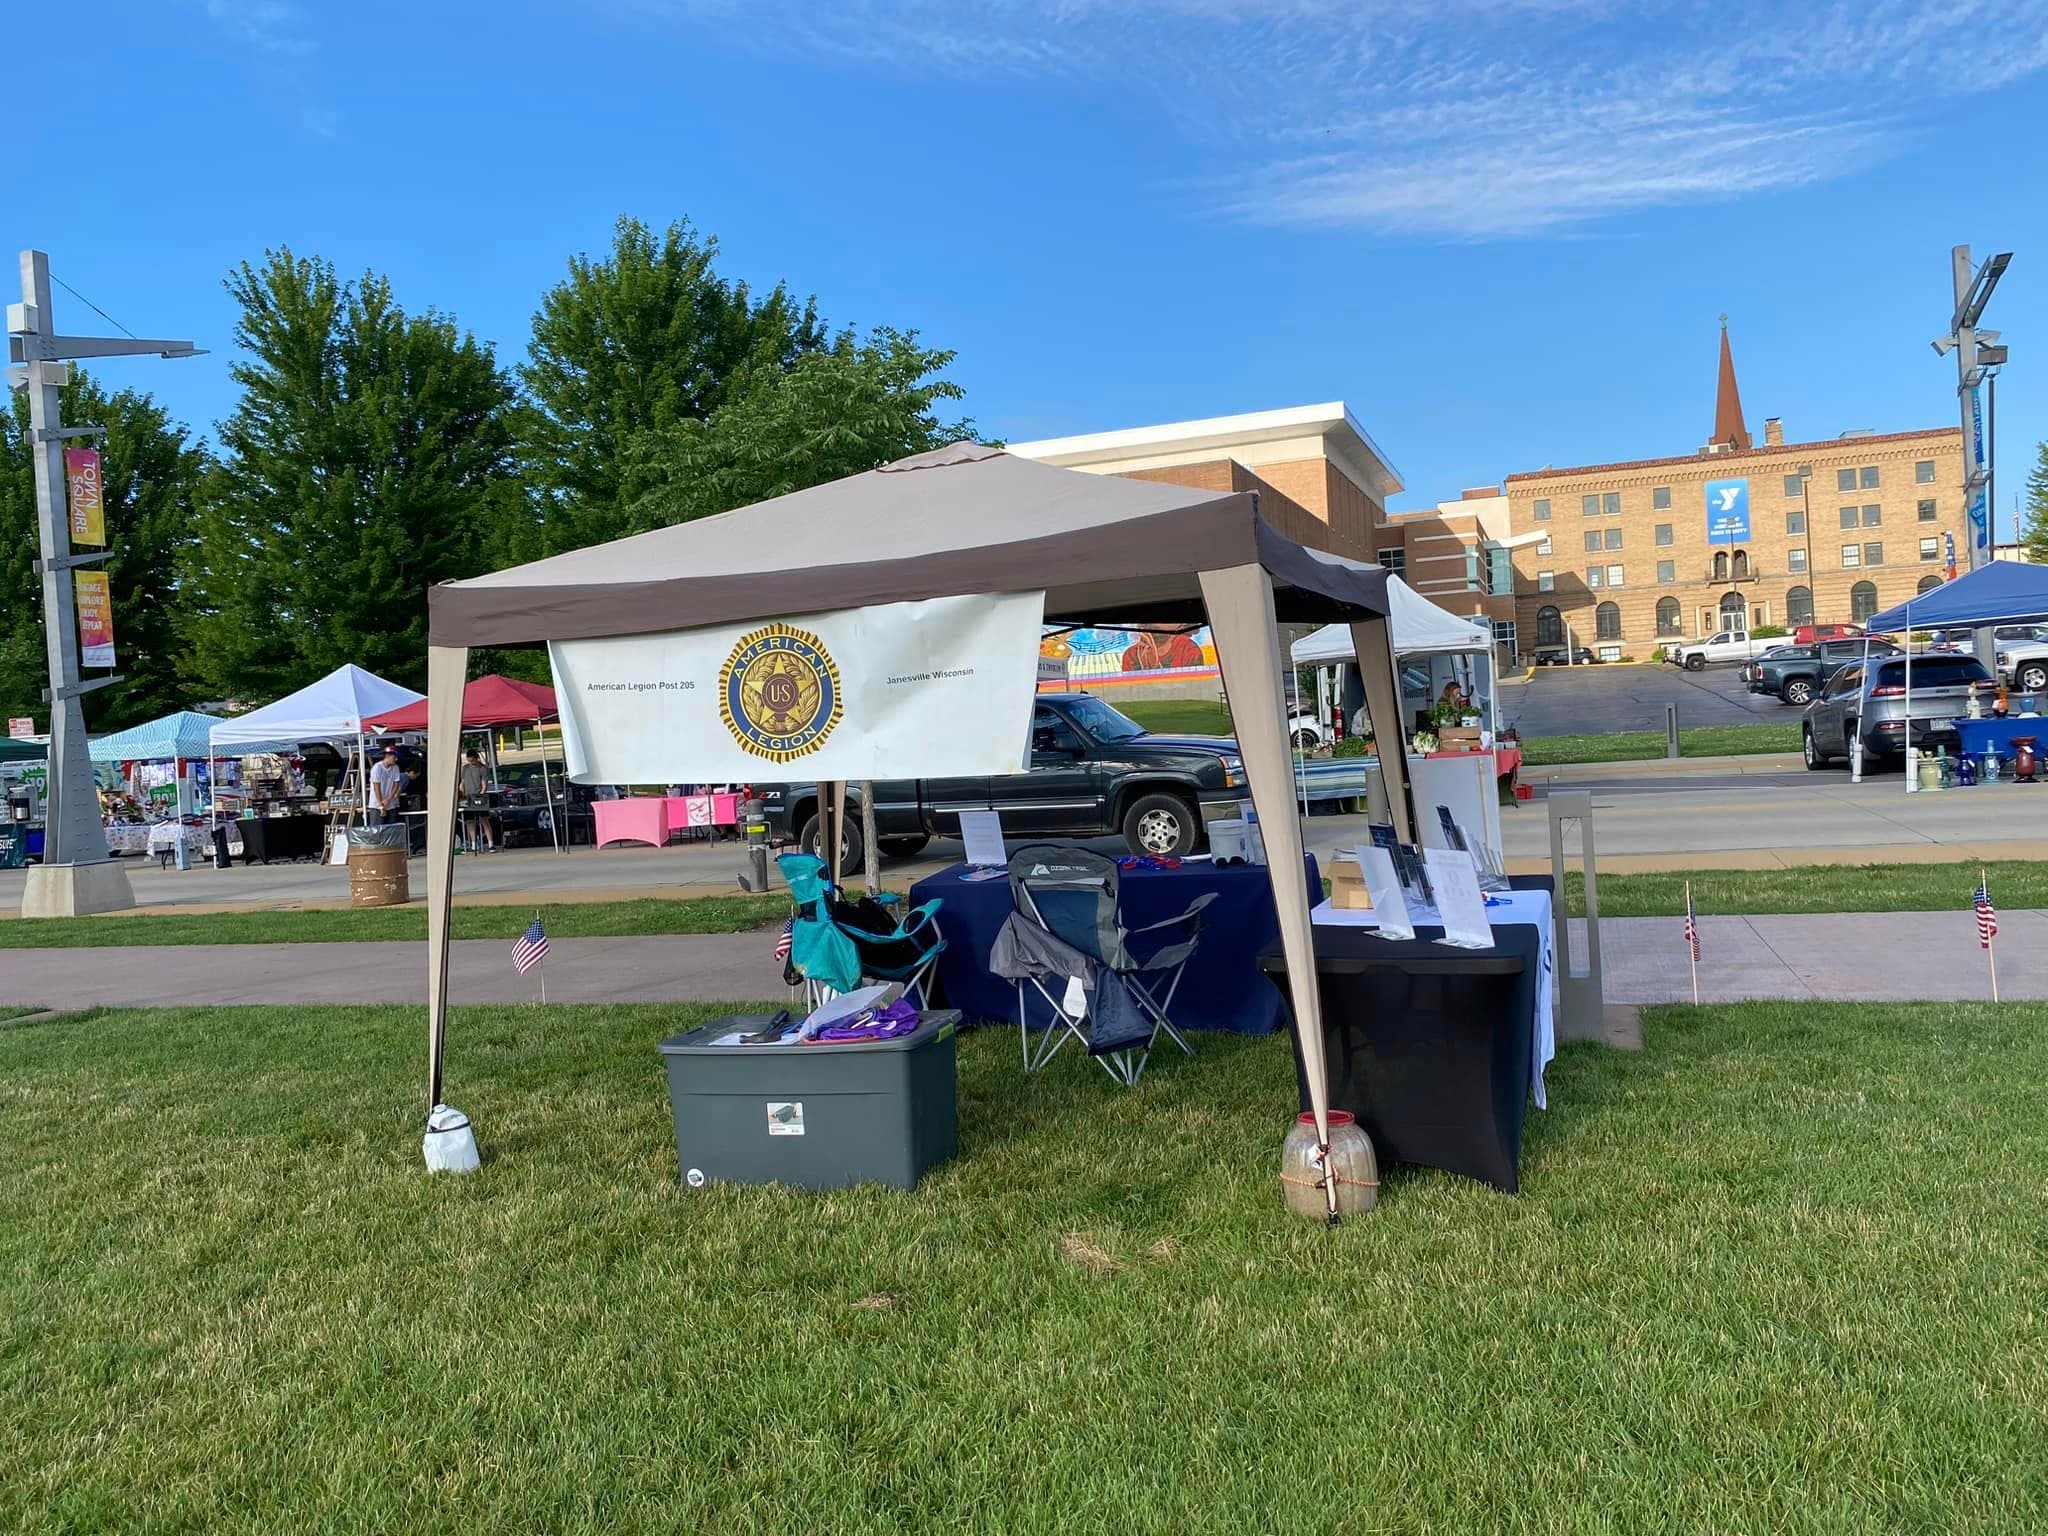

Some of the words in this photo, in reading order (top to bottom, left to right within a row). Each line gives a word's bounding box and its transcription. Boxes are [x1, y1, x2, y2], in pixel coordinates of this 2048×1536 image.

[83, 462, 99, 509] TOWN
[72, 475, 88, 534] SQUARE
[733, 638, 828, 679] AMERICAN
[588, 683, 626, 691] American
[628, 682, 657, 692] Legion
[659, 681, 678, 690] Post
[680, 681, 695, 690] 205
[887, 672, 930, 685] Janesville
[932, 667, 974, 679] Wisconsin
[747, 726, 817, 749] LEGION
[759, 791, 781, 799] Z71
